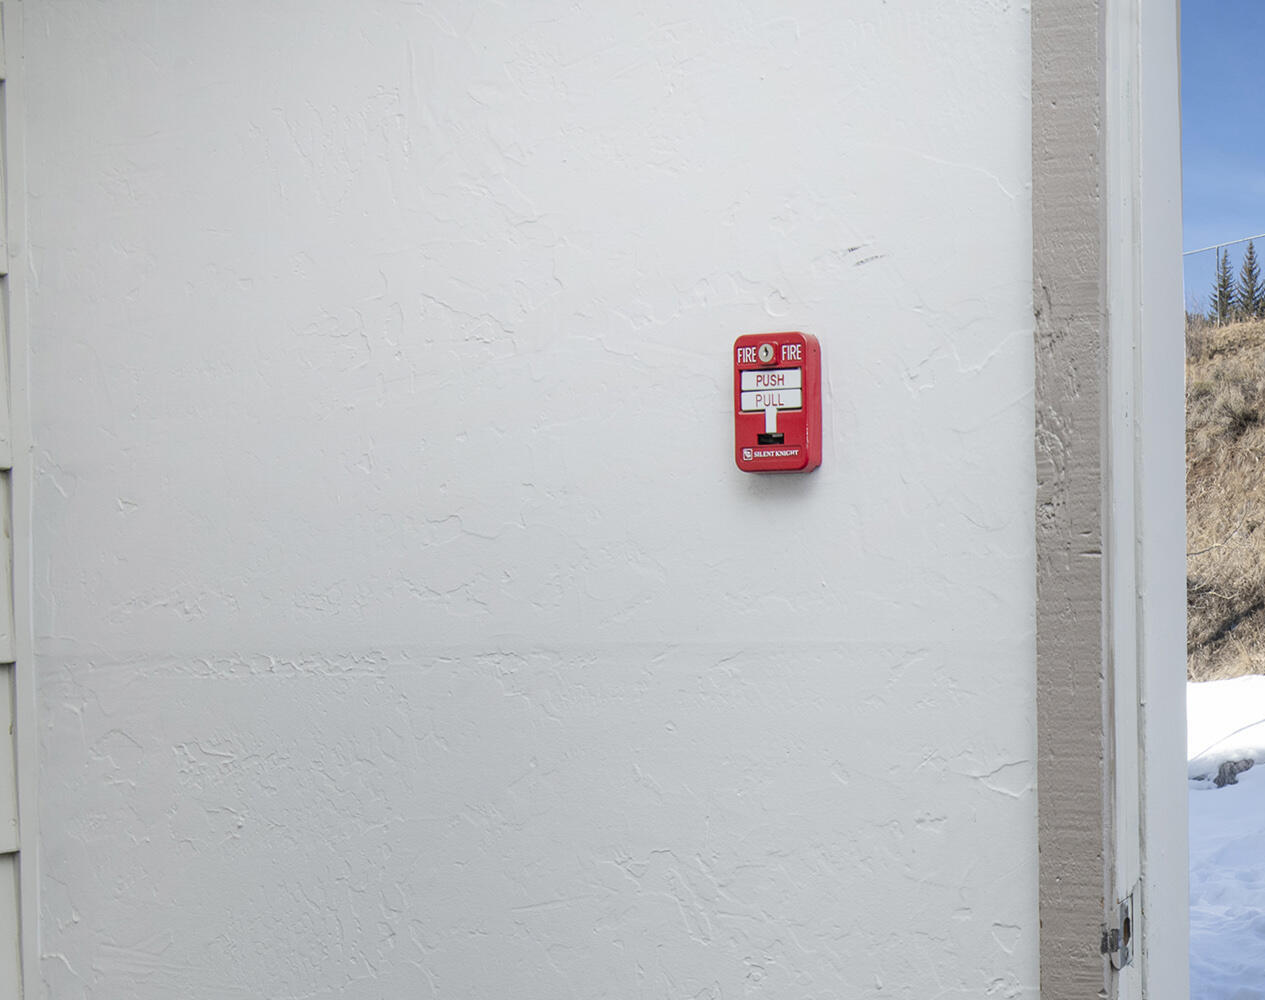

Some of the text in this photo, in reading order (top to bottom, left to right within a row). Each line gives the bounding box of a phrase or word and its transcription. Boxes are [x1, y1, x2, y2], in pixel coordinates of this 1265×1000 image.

[737, 343, 802, 363] FIRE FIRE
[756, 373, 785, 387] PUSH
[755, 393, 784, 407] PULL
[753, 449, 799, 458] SILENT KNIGHT
